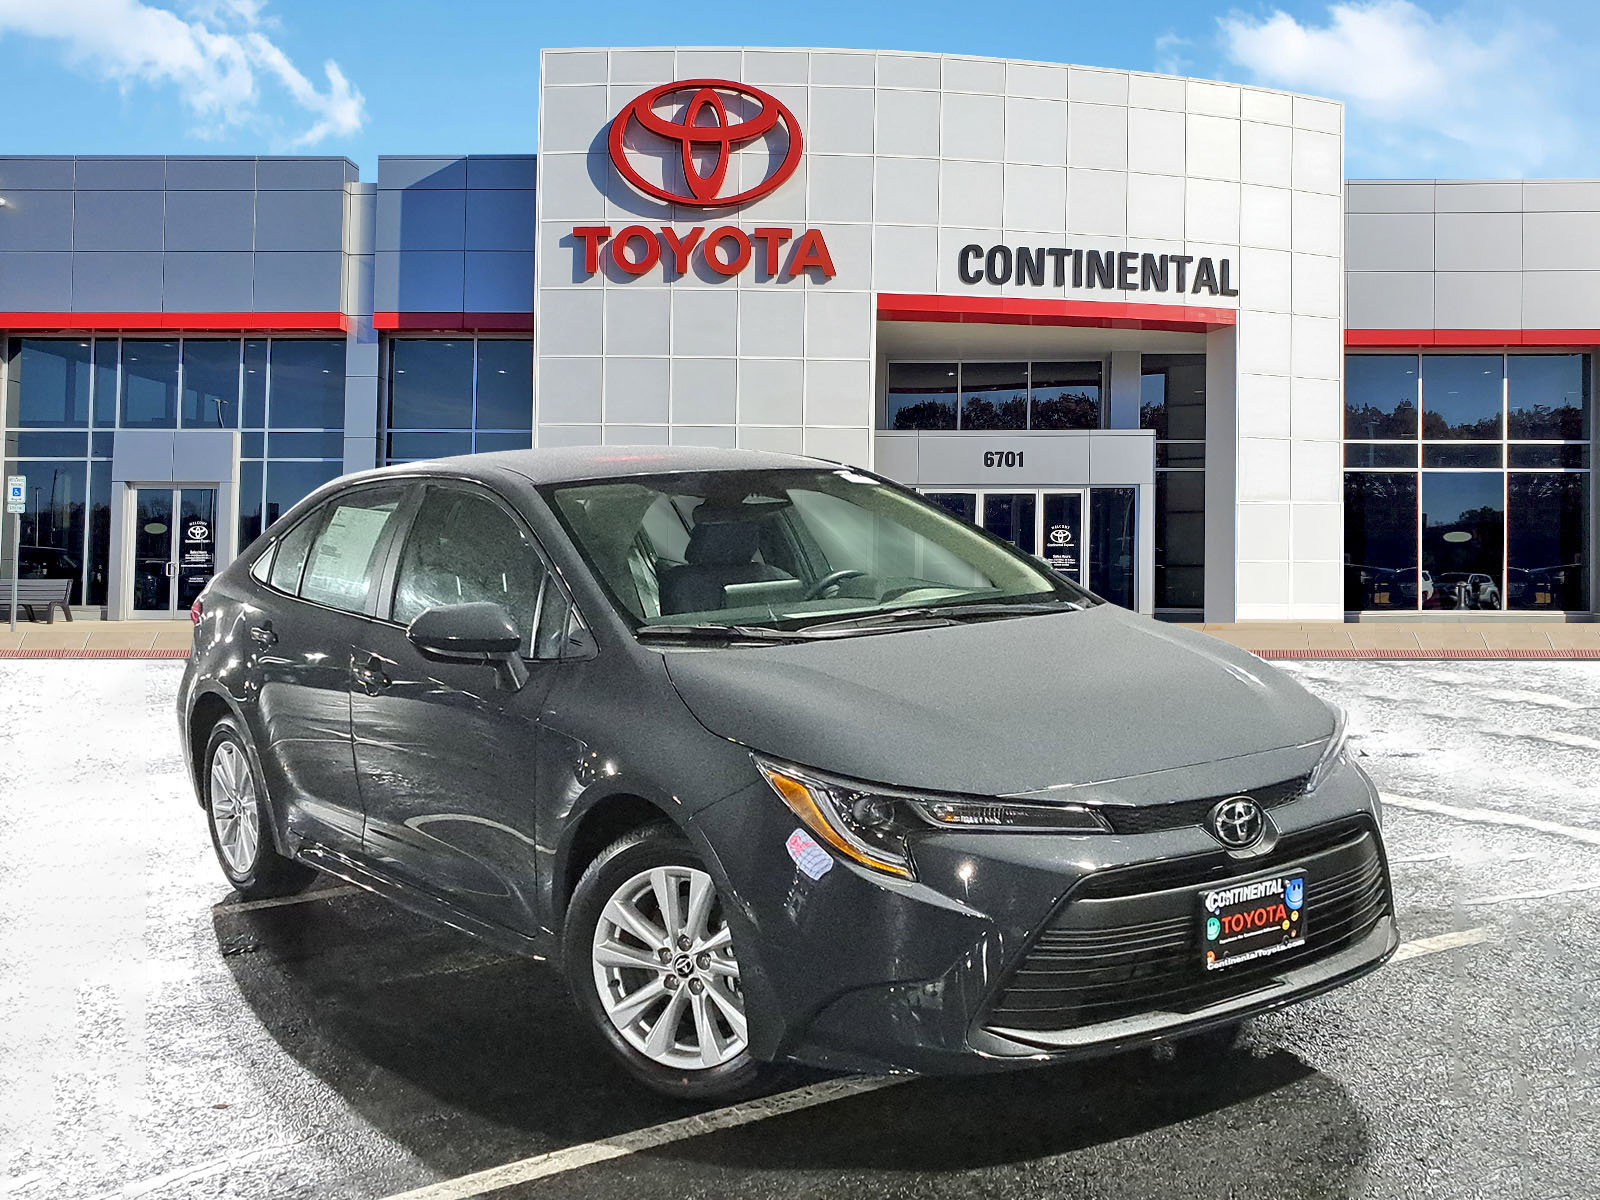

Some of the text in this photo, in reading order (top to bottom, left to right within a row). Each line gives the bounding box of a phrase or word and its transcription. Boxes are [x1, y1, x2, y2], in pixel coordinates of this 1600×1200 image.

[573, 225, 837, 277] TOYOTA
[958, 244, 1239, 297] CONTINENTAL
[983, 451, 1024, 468] 6701
[1205, 878, 1284, 913] CONTINENTAL
[1221, 903, 1287, 934] TOYOTA
